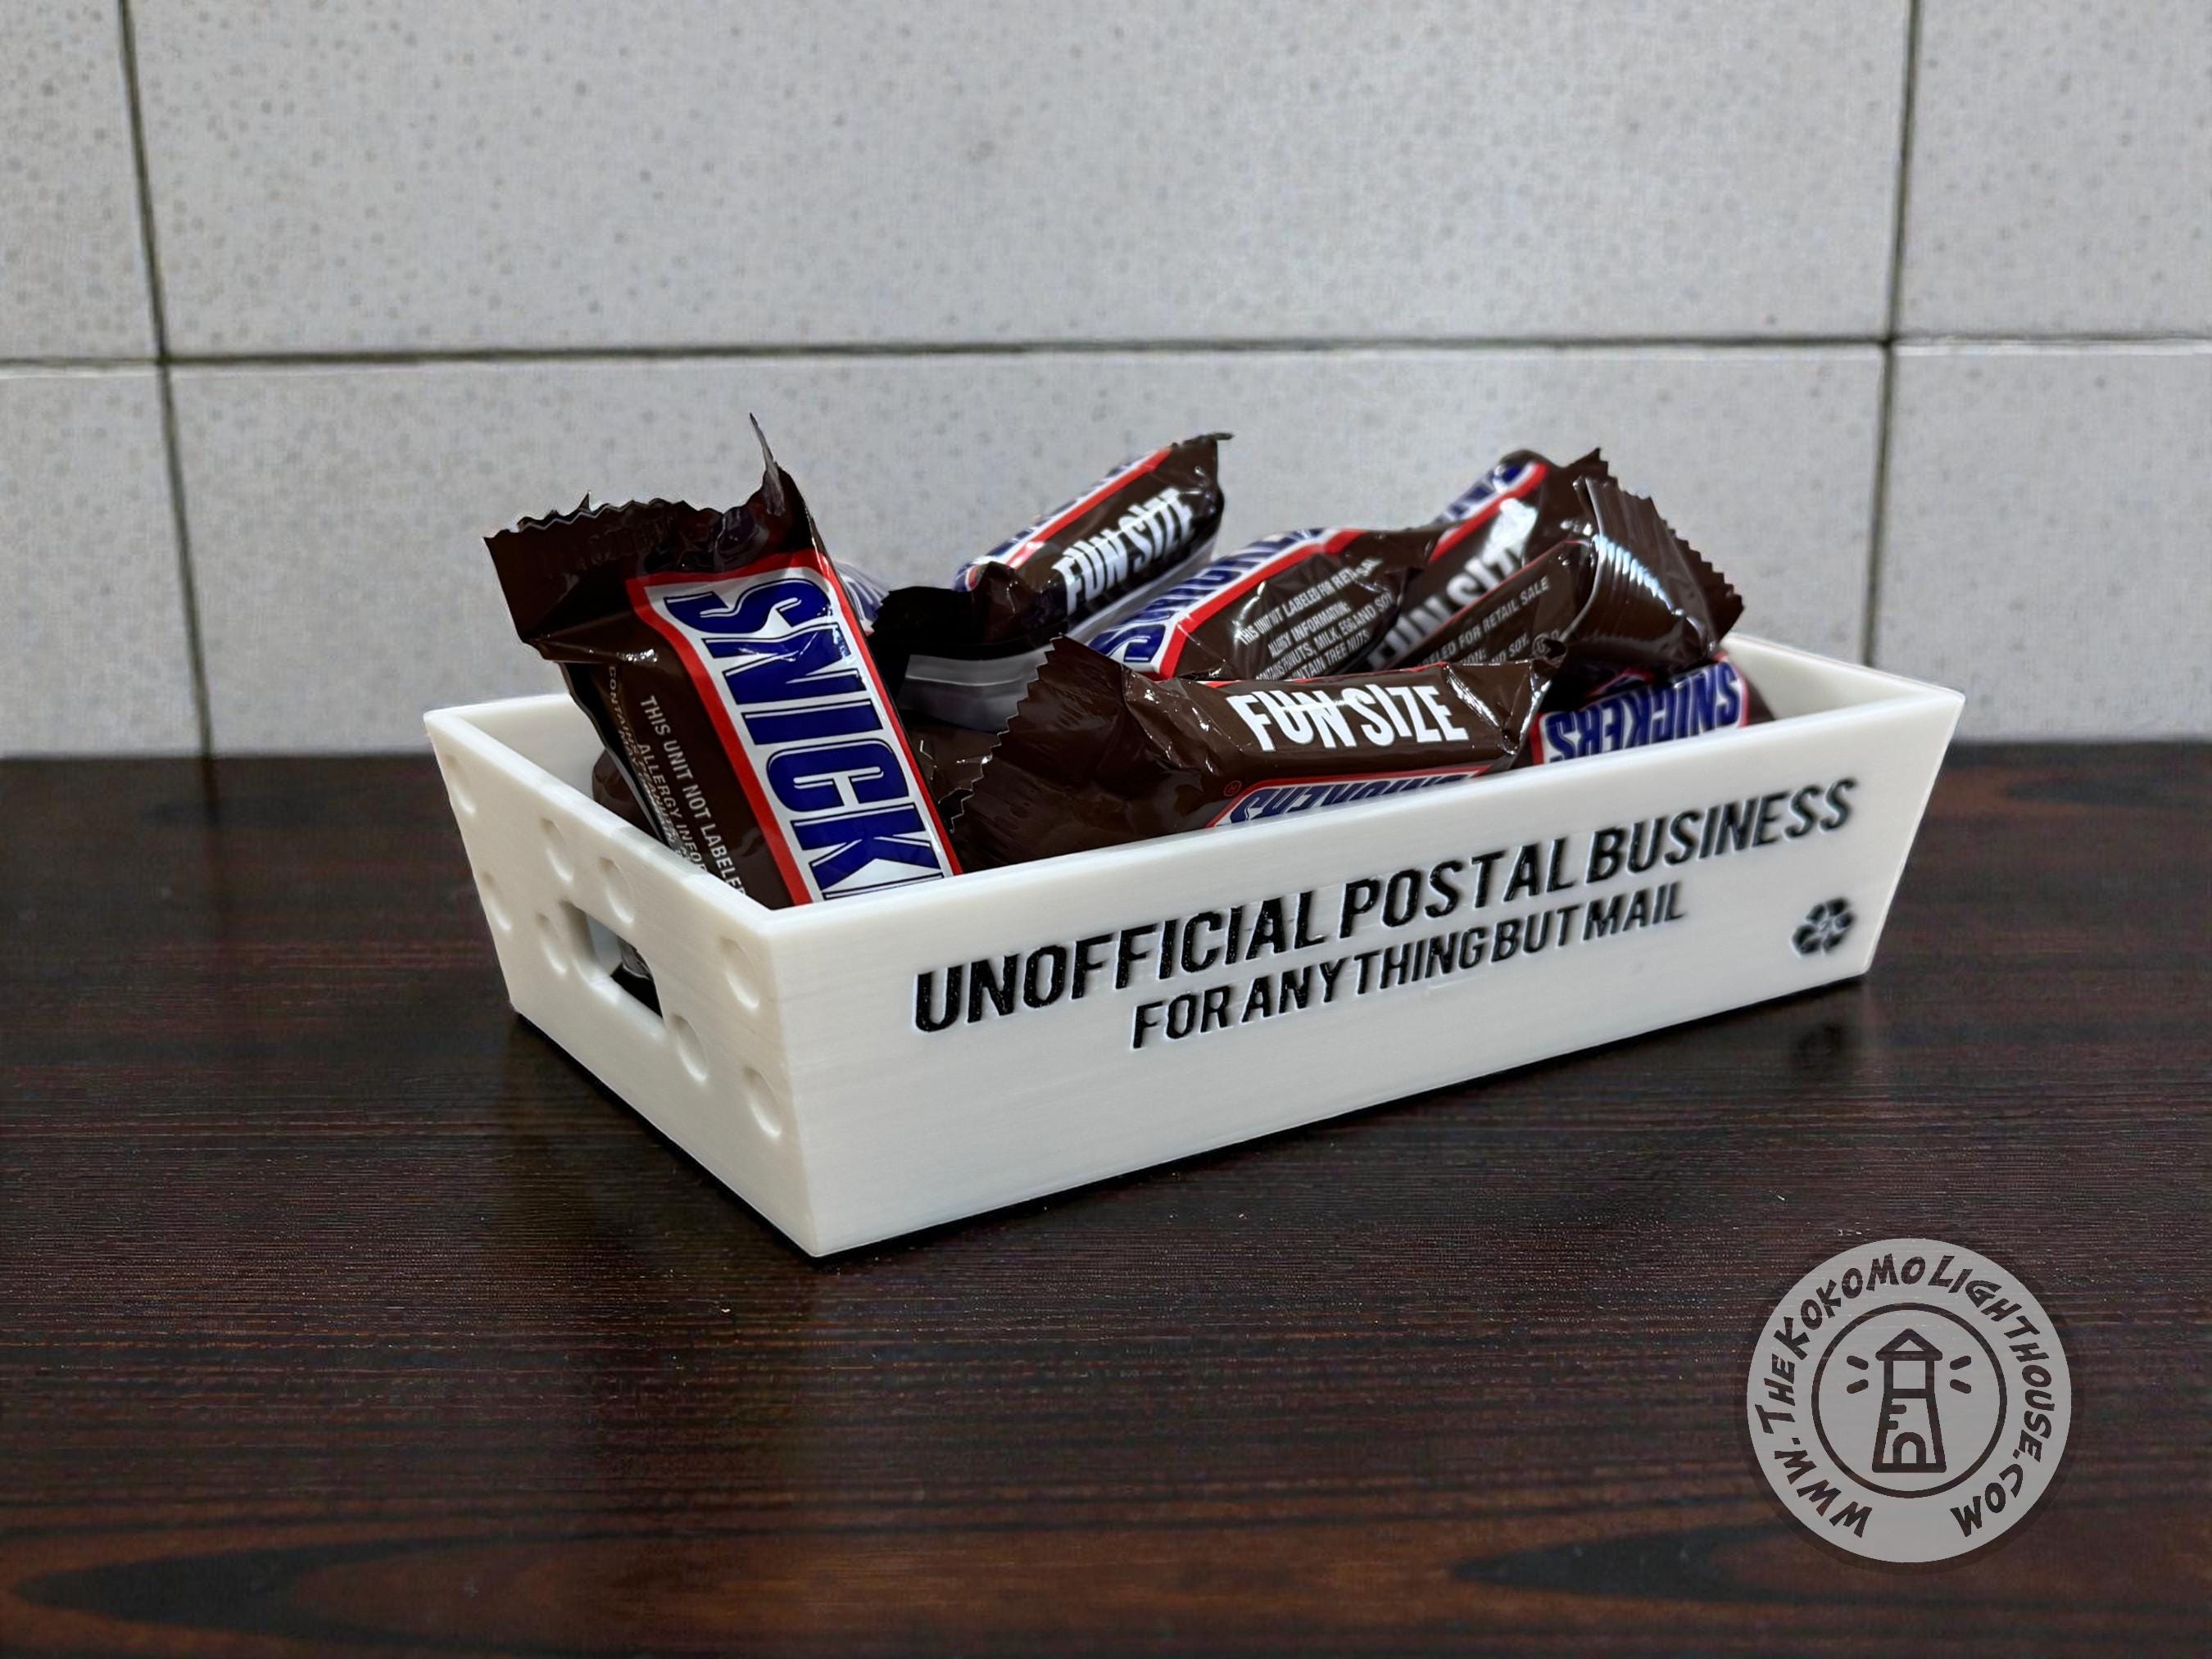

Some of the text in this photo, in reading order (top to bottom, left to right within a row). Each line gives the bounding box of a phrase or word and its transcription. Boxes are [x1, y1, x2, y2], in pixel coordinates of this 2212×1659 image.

[1051, 528, 1129, 616] FUN
[1118, 487, 1194, 573] SIZE
[1238, 626, 1258, 646] THIS
[1282, 587, 1321, 617] LABELED
[1313, 627, 1342, 650] MILK,
[1353, 604, 1377, 630] AND
[1458, 625, 1482, 649] FOR
[1482, 602, 1521, 632] RETAIL
[1520, 575, 1550, 605] SALE
[1324, 642, 1348, 667] TREE
[664, 578, 945, 900] SNICK
[1226, 684, 1469, 752] FUN SIZE
[637, 743, 682, 818] ALLERGY
[641, 695, 671, 735] THIS
[664, 740, 693, 780] UNIT
[682, 784, 711, 818] NOT
[700, 823, 746, 895] LABELE
[913, 889, 1327, 1034] UNOFFICIAL
[1338, 837, 1576, 940] POSTAL
[1586, 777, 1861, 886] BUSINESS
[1131, 880, 1689, 1050] FOR ANYTHING BUT MAIL
